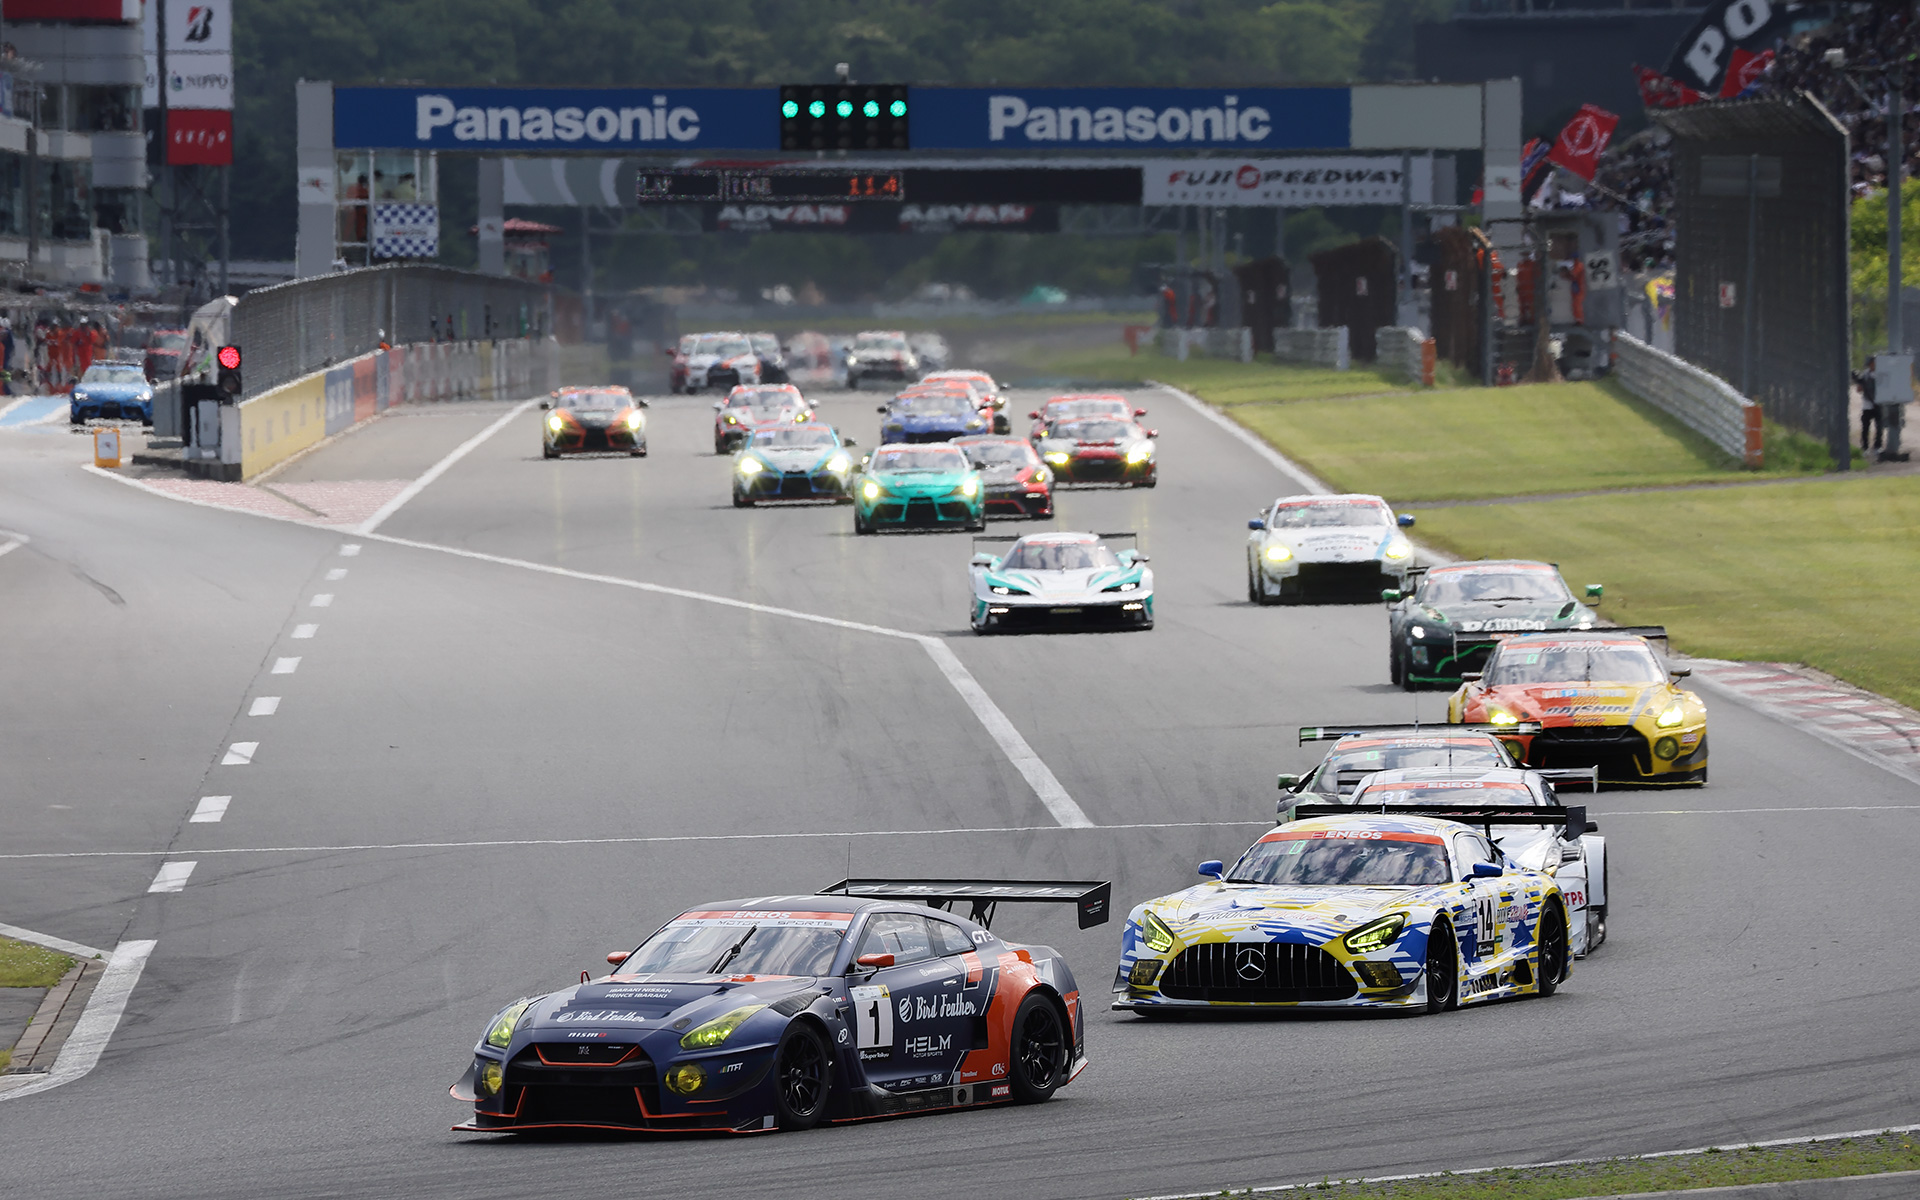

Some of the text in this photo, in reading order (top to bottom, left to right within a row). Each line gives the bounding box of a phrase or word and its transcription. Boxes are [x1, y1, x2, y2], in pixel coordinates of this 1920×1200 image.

[416, 95, 700, 142] Panasonic
[988, 95, 1272, 142] Panasonic
[717, 203, 850, 226] ADVAN
[1544, 705, 1631, 717] DAISHIN
[1326, 831, 1383, 840] ENEOS
[733, 911, 791, 919] ENEOS
[1478, 899, 1494, 940] 14
[972, 930, 994, 944] GT3
[916, 992, 977, 1021] Bird Feather
[869, 1001, 880, 1045] 1
[905, 1033, 952, 1054] HELM
[992, 1086, 1009, 1096] MOTUL
